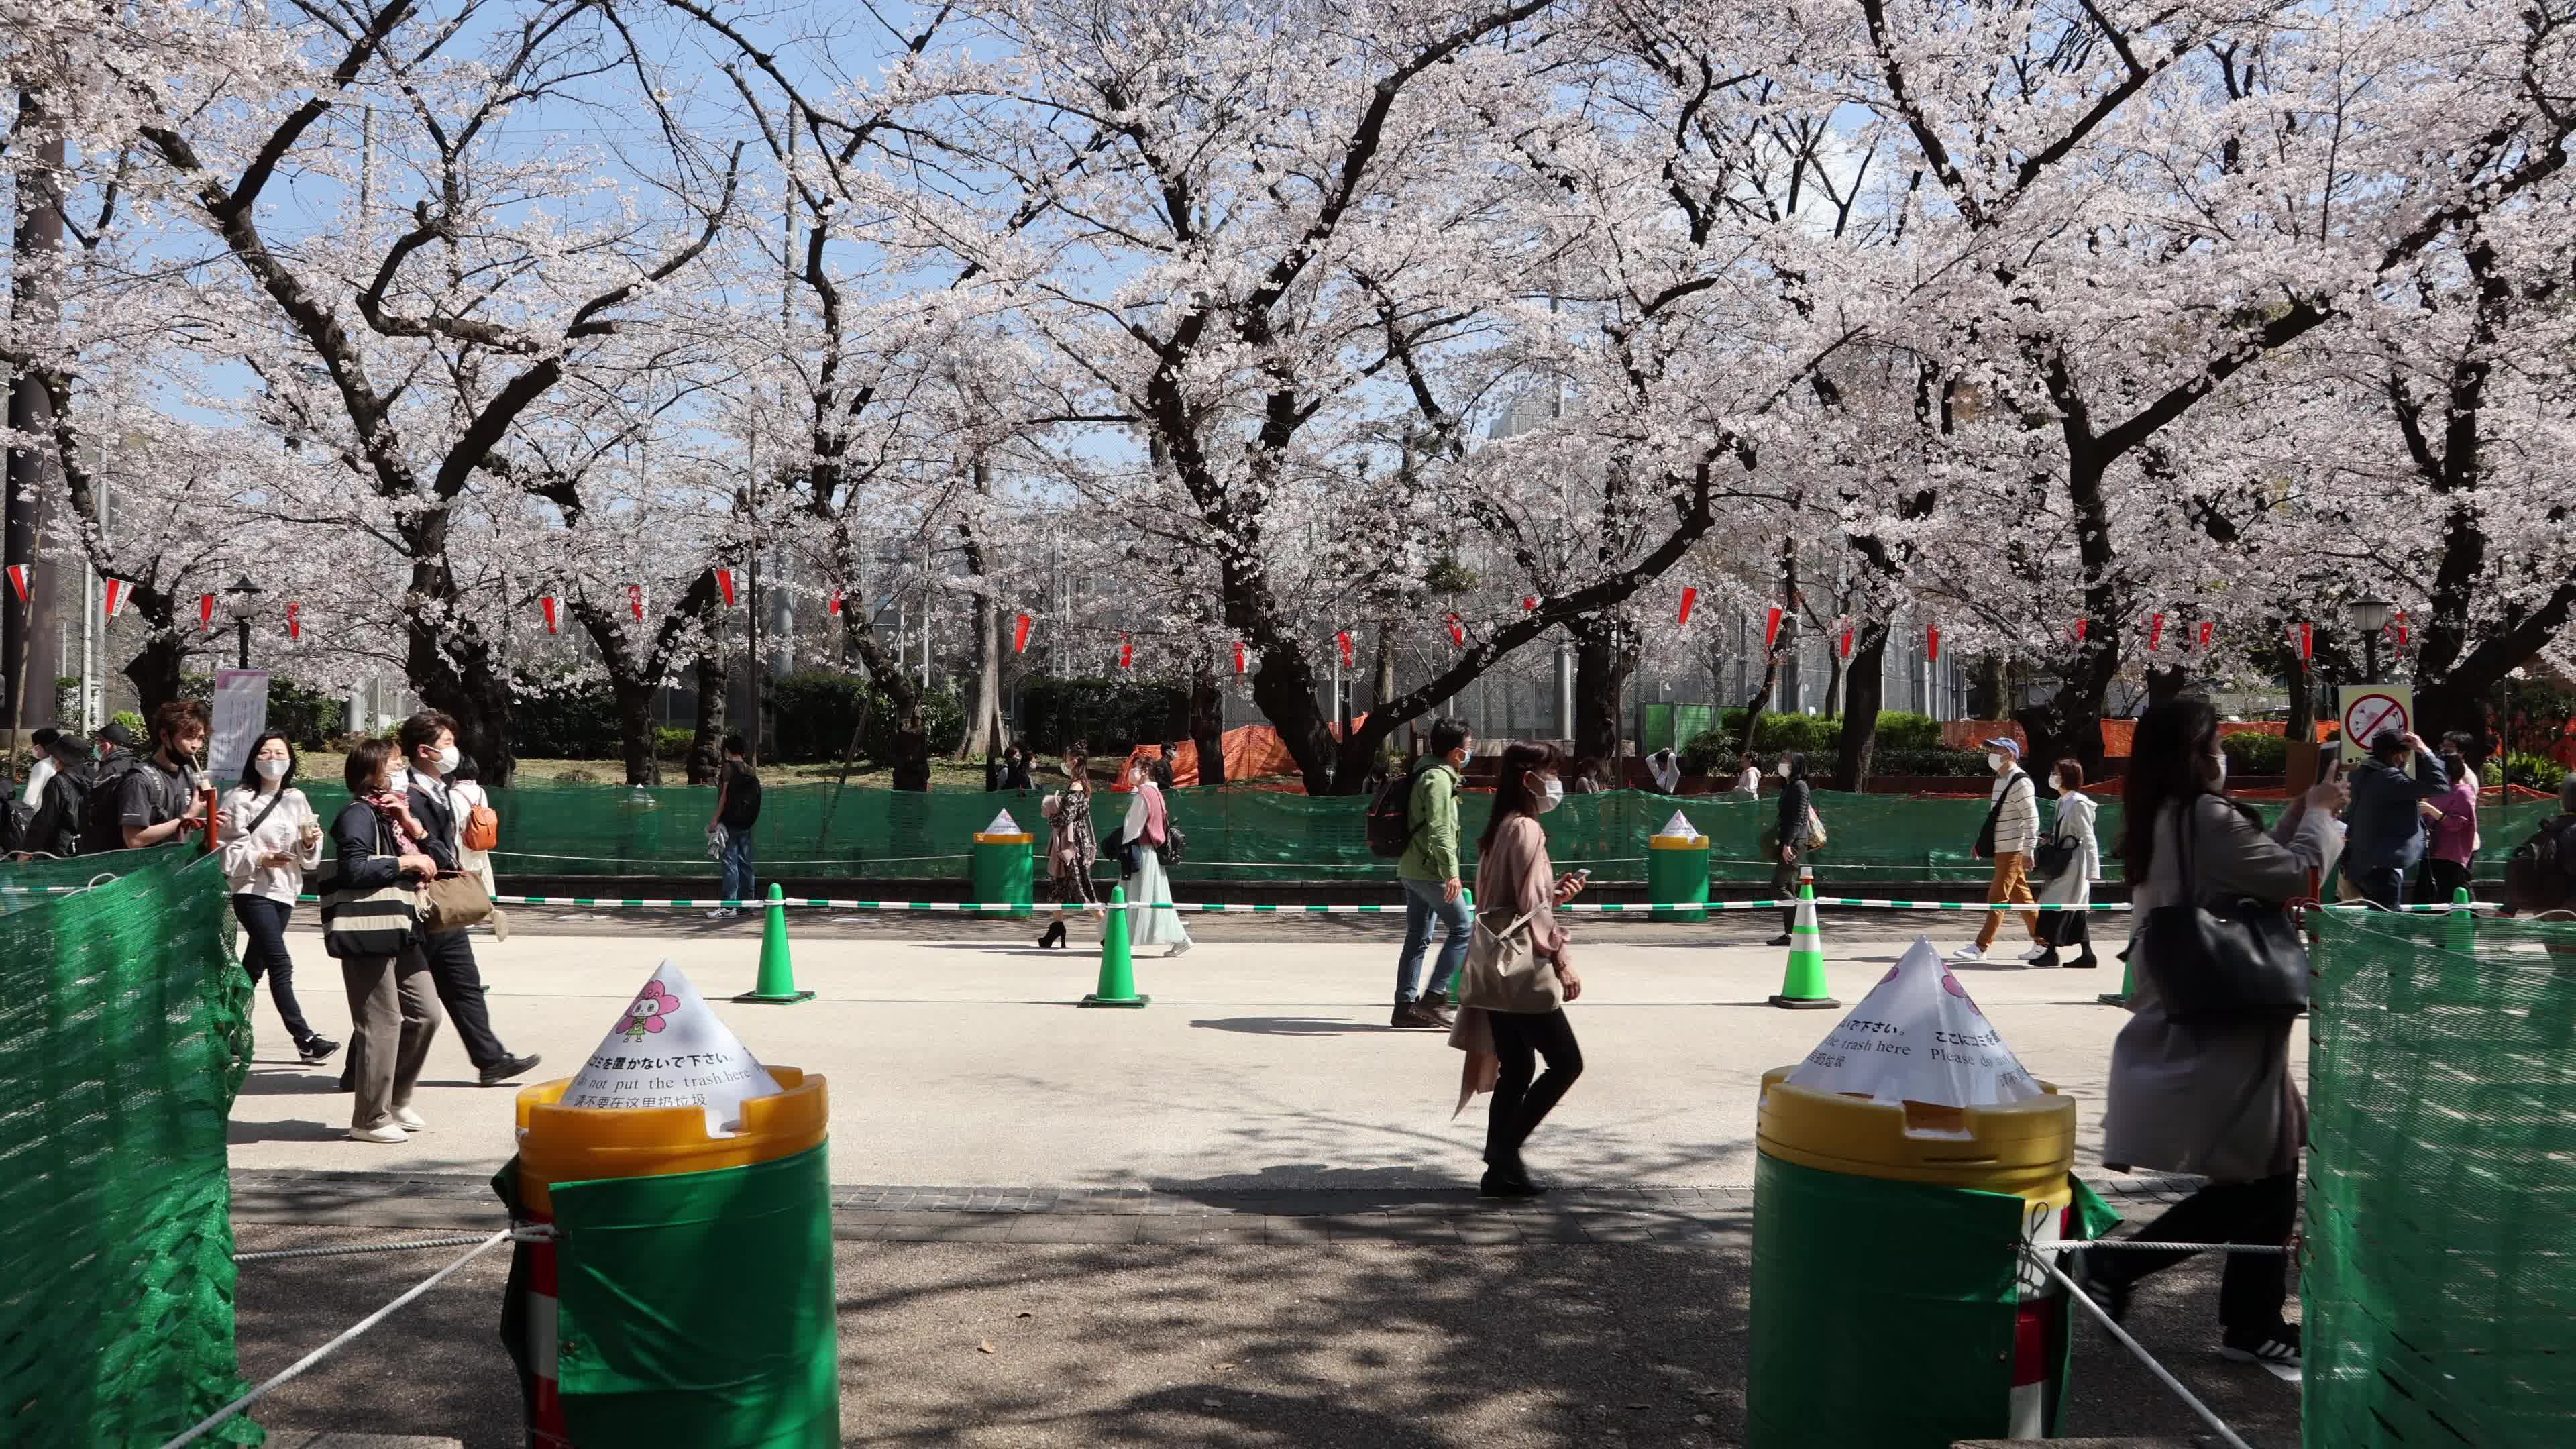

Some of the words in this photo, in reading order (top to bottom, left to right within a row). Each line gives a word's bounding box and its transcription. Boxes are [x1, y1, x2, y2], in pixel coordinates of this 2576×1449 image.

[1876, 1040, 1911, 1055] here
[1931, 1048, 1975, 1065] Please
[589, 1079, 608, 1089] not
[613, 1080, 639, 1093] put
[649, 1077, 674, 1089] the
[684, 1073, 720, 1087] trash
[723, 1069, 751, 1083] here
